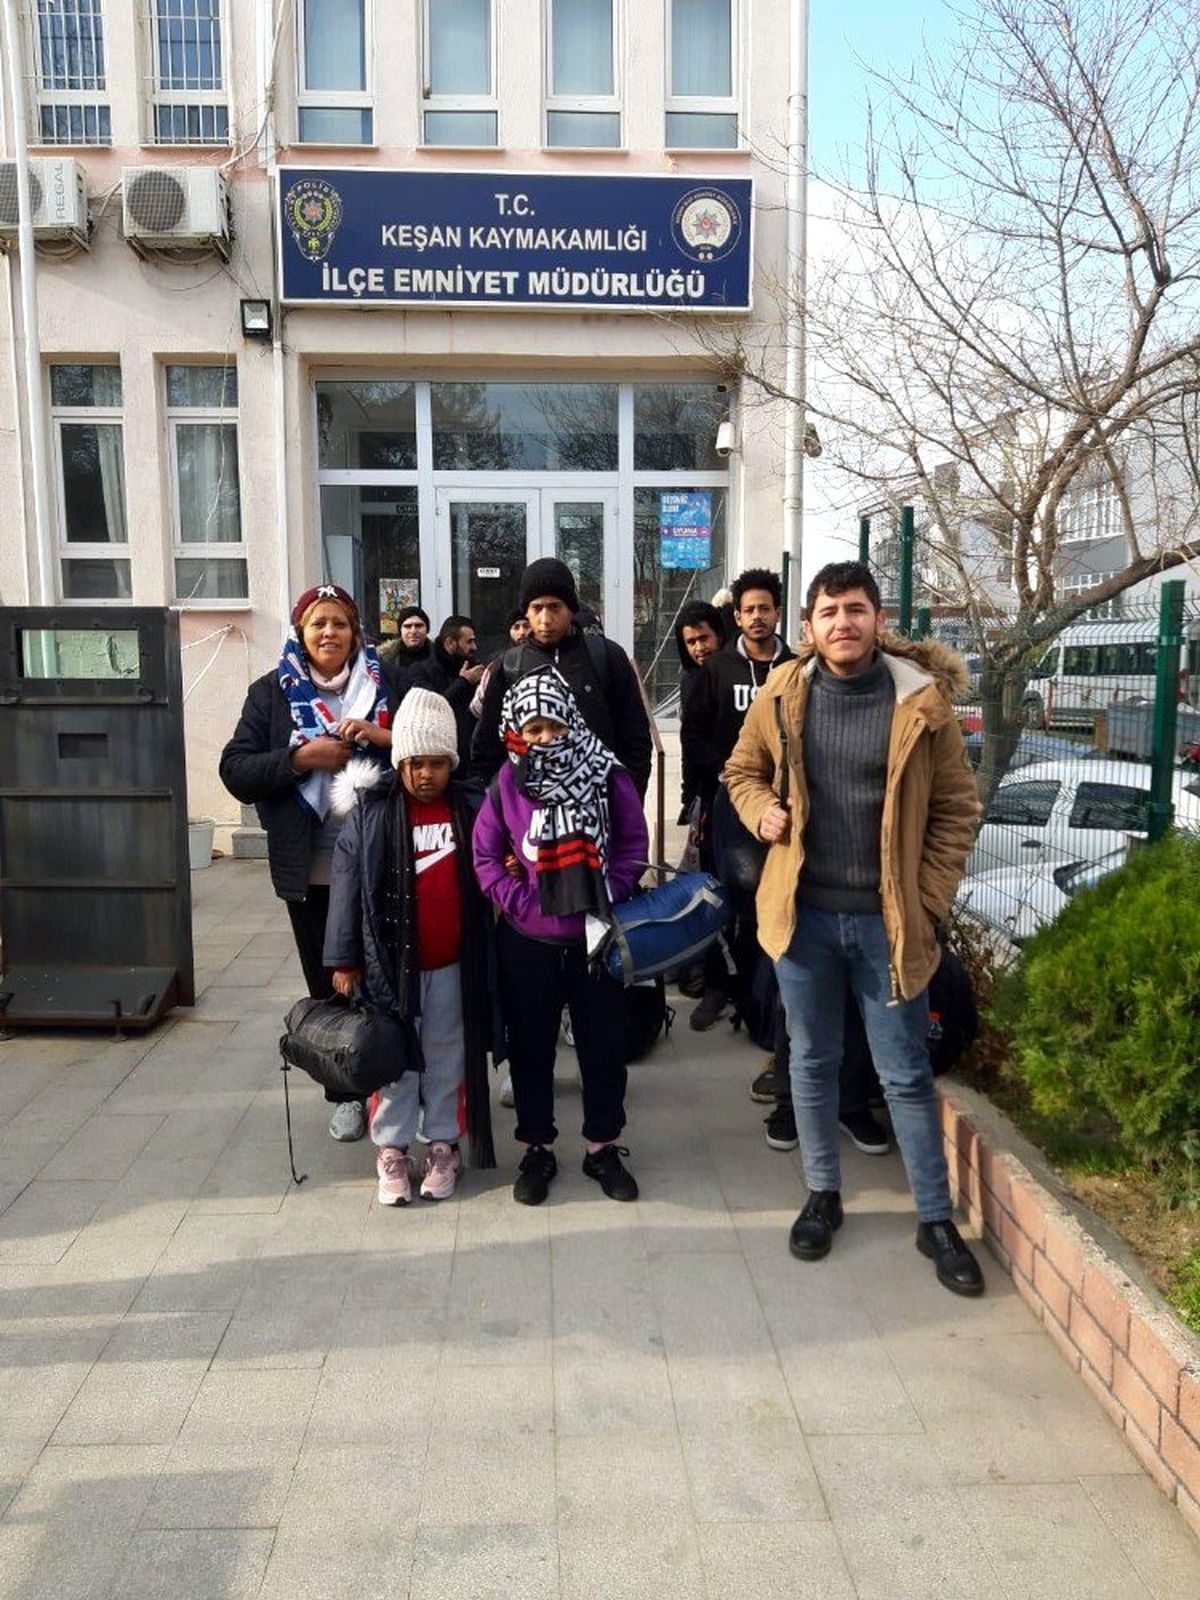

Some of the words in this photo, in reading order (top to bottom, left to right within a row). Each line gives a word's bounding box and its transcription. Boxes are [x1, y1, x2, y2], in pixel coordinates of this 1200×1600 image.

[55, 162, 65, 219] REGAL
[494, 194, 536, 216] T.C.
[381, 224, 462, 252] KEŞAN
[469, 224, 648, 252] KAYMAKAMLIĞI
[322, 262, 384, 297] İLÇE
[394, 264, 519, 295] EMNİYET
[528, 267, 706, 298] MÜDÜRLÜĞÜ
